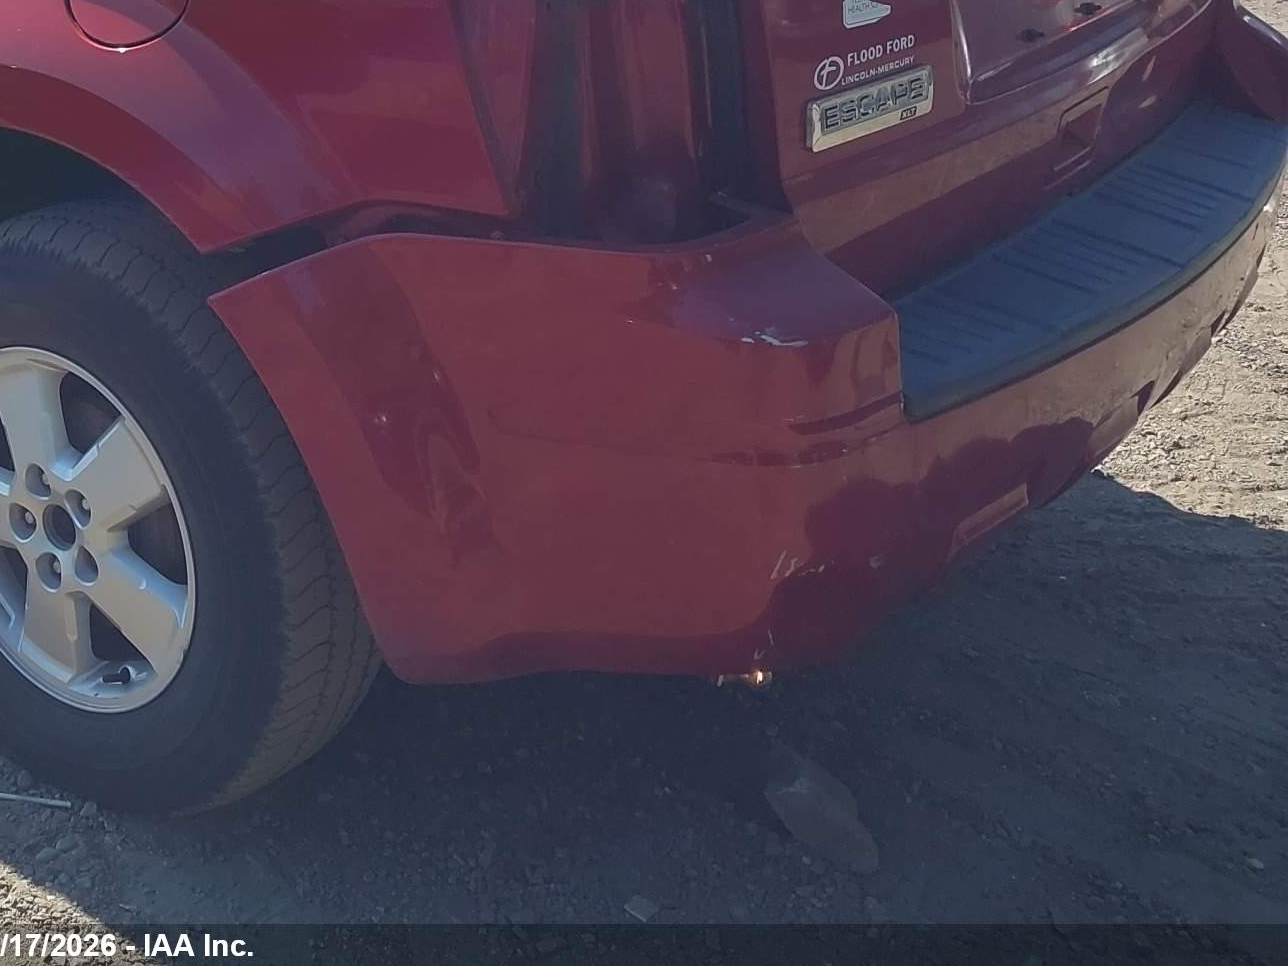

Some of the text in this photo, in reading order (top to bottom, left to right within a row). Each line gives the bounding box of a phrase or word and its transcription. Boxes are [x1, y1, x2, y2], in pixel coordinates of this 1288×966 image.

[847, 34, 915, 67] FLOOD FORD
[841, 56, 914, 86] LINCOLN-MERCURY
[823, 76, 925, 130] ESCAPE
[901, 107, 916, 120] XLT
